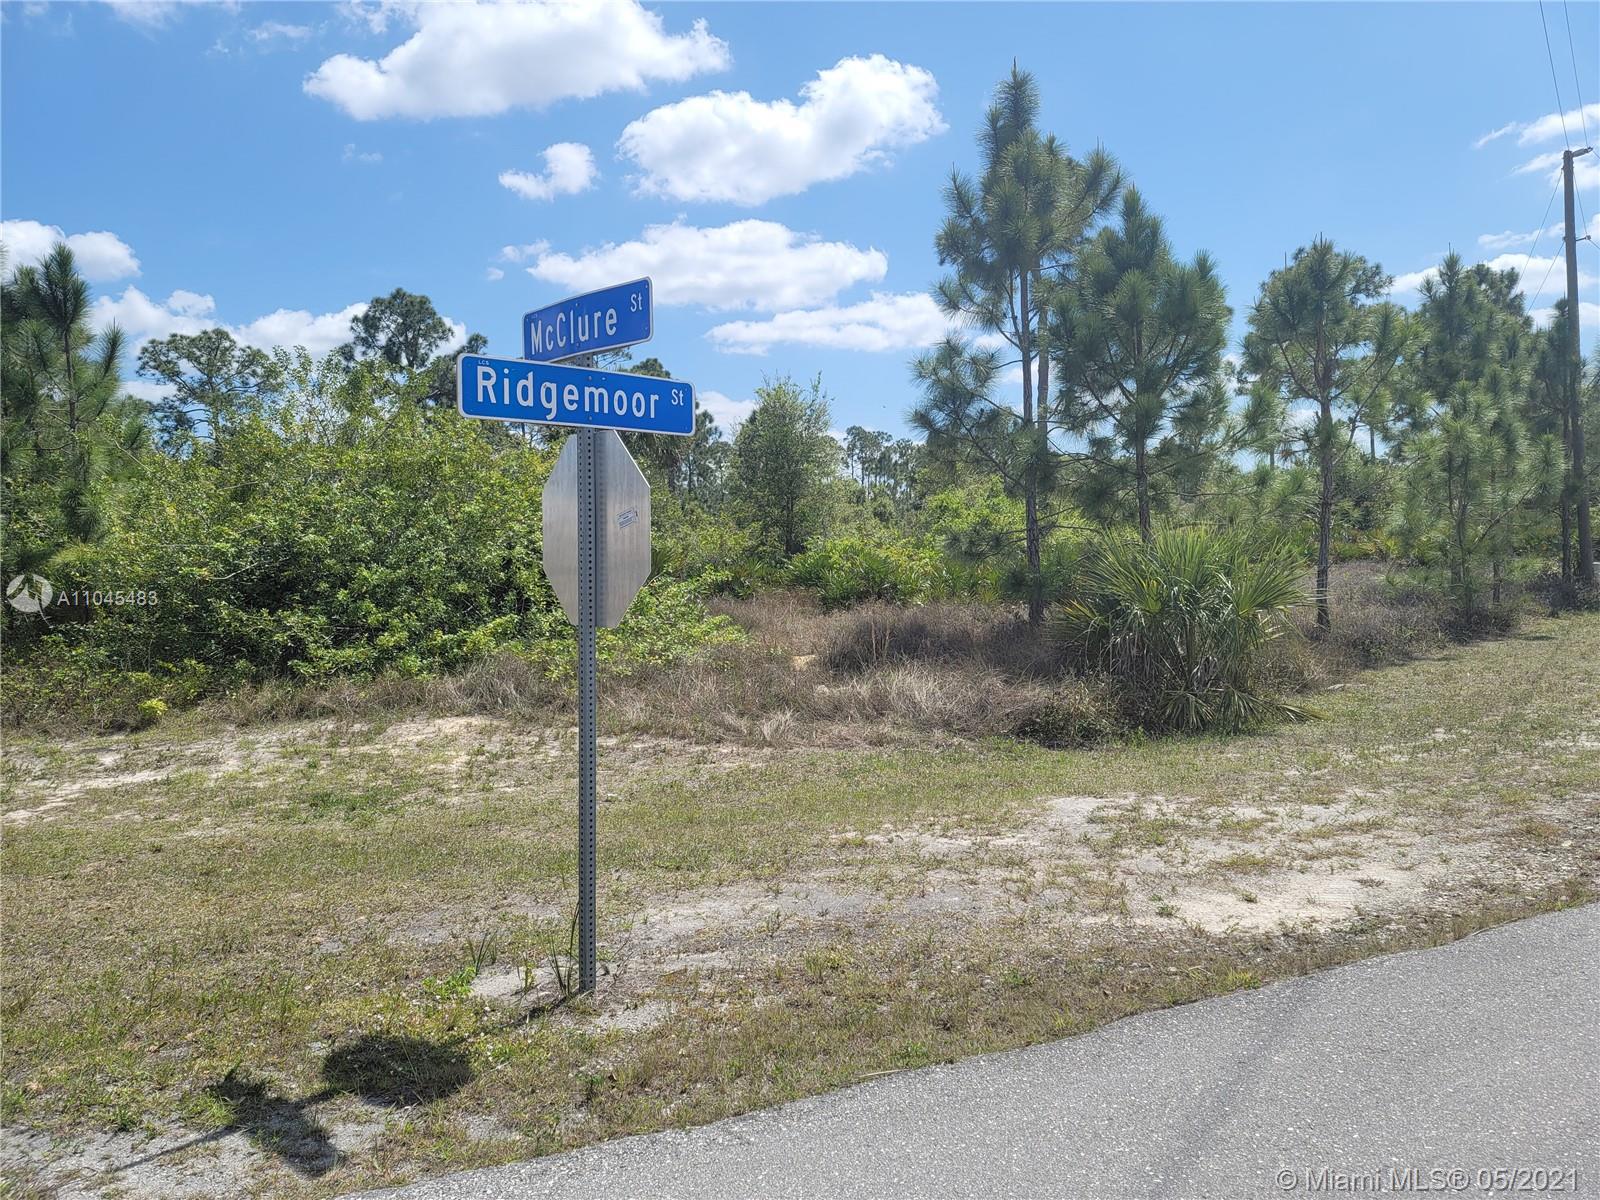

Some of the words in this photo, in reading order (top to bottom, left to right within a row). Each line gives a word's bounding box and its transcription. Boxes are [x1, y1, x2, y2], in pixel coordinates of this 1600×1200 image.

[530, 307, 618, 355] McClure
[630, 293, 643, 313] St
[476, 365, 659, 420] Ridgemoor
[671, 388, 684, 407] St
